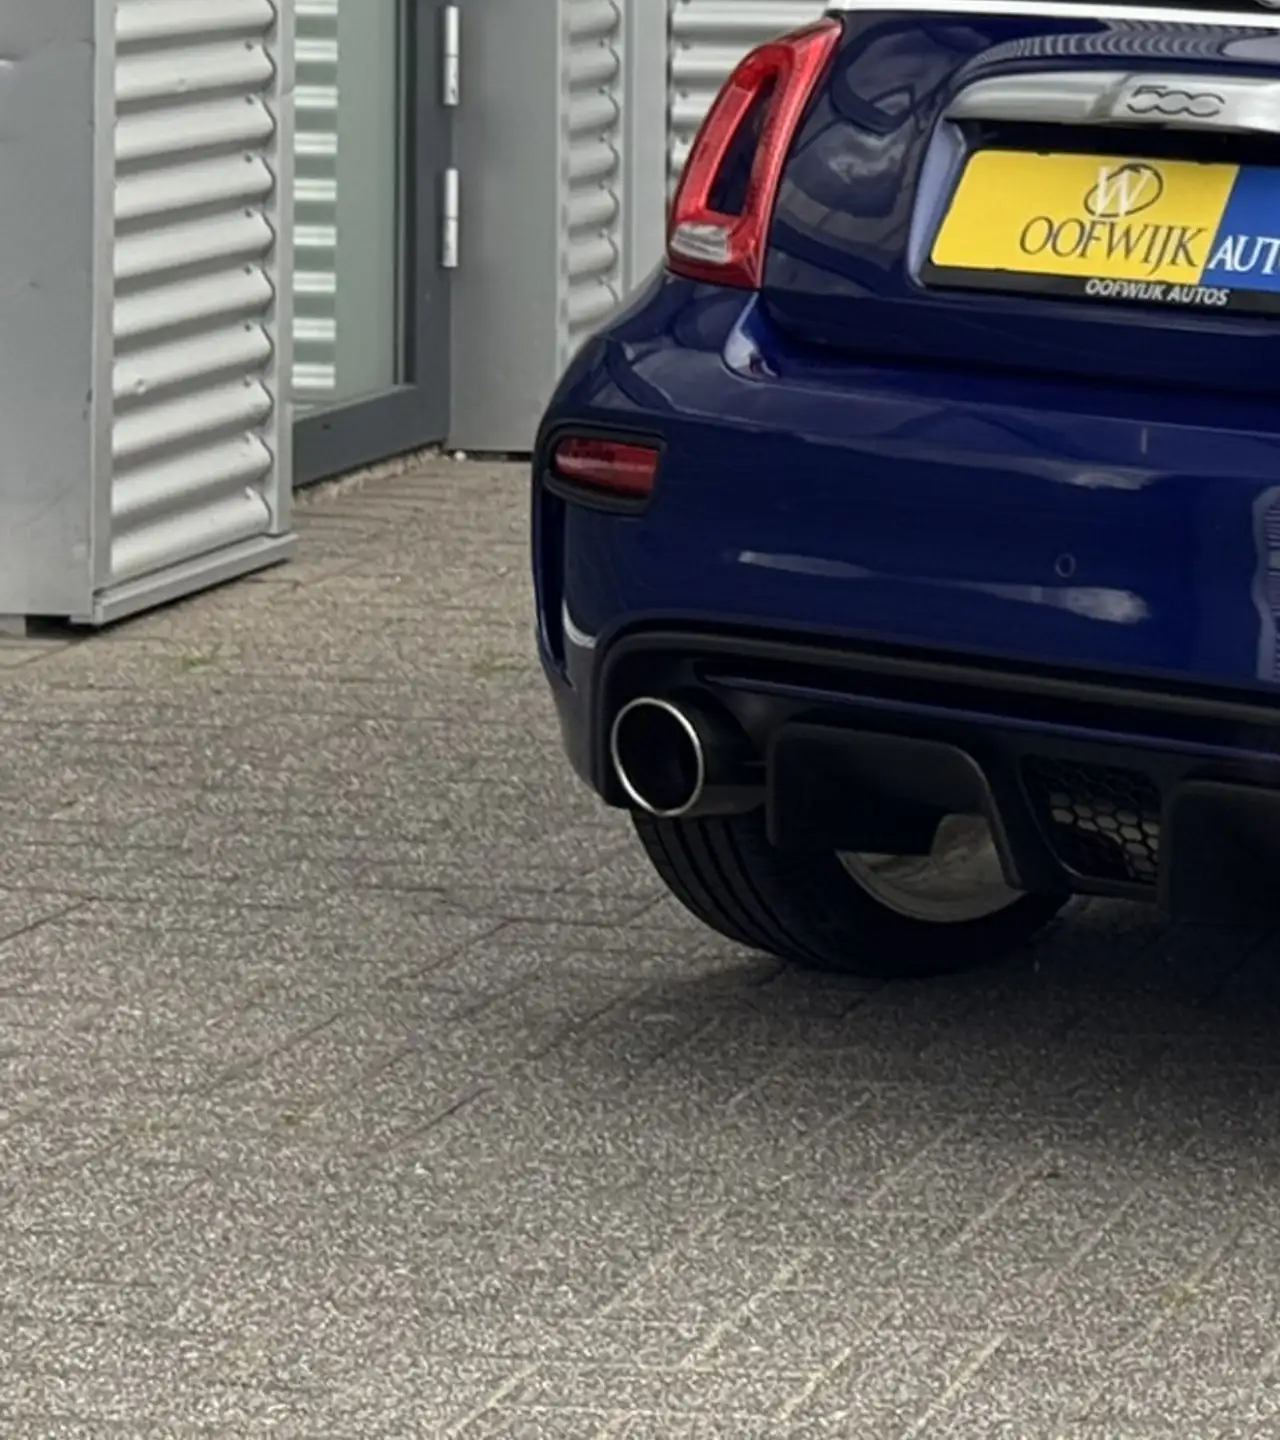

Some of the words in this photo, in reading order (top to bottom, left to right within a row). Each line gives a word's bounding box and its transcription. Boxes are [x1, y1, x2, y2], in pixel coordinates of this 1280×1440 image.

[1126, 84, 1225, 118] 500
[1019, 215, 1209, 276] OOFWIJK
[1085, 278, 1167, 301] OOFWIJK
[1167, 286, 1230, 306] AUTOS
